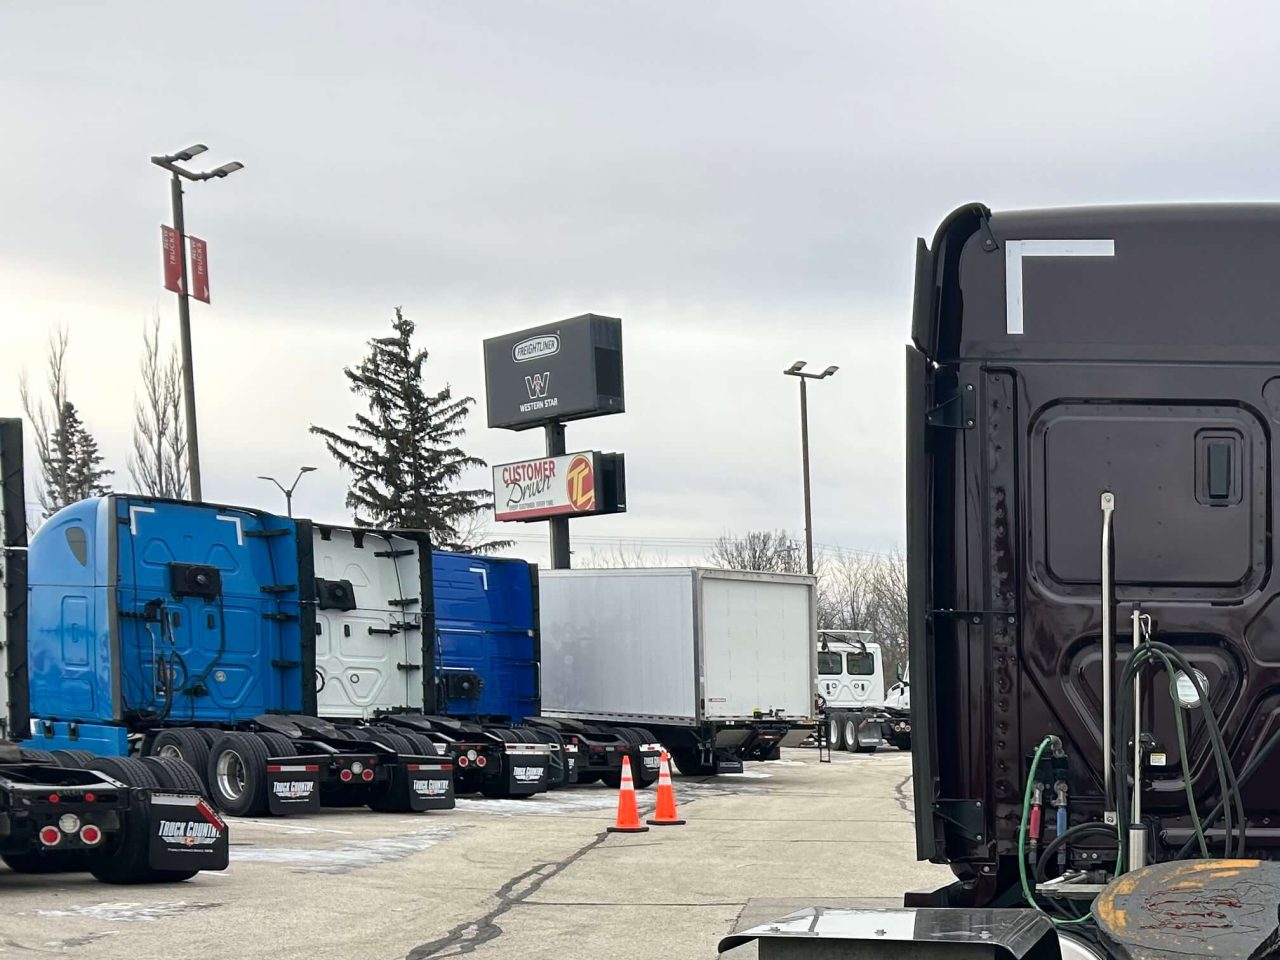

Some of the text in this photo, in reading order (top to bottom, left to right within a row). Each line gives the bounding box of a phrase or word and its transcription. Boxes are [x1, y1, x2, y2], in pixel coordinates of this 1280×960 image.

[517, 339, 555, 357] FREIGHTLINER
[519, 398, 558, 412] WESTERN STAR
[502, 460, 556, 484] CUSTOMER
[505, 475, 552, 506] Driven
[158, 820, 186, 837] TRUCK
